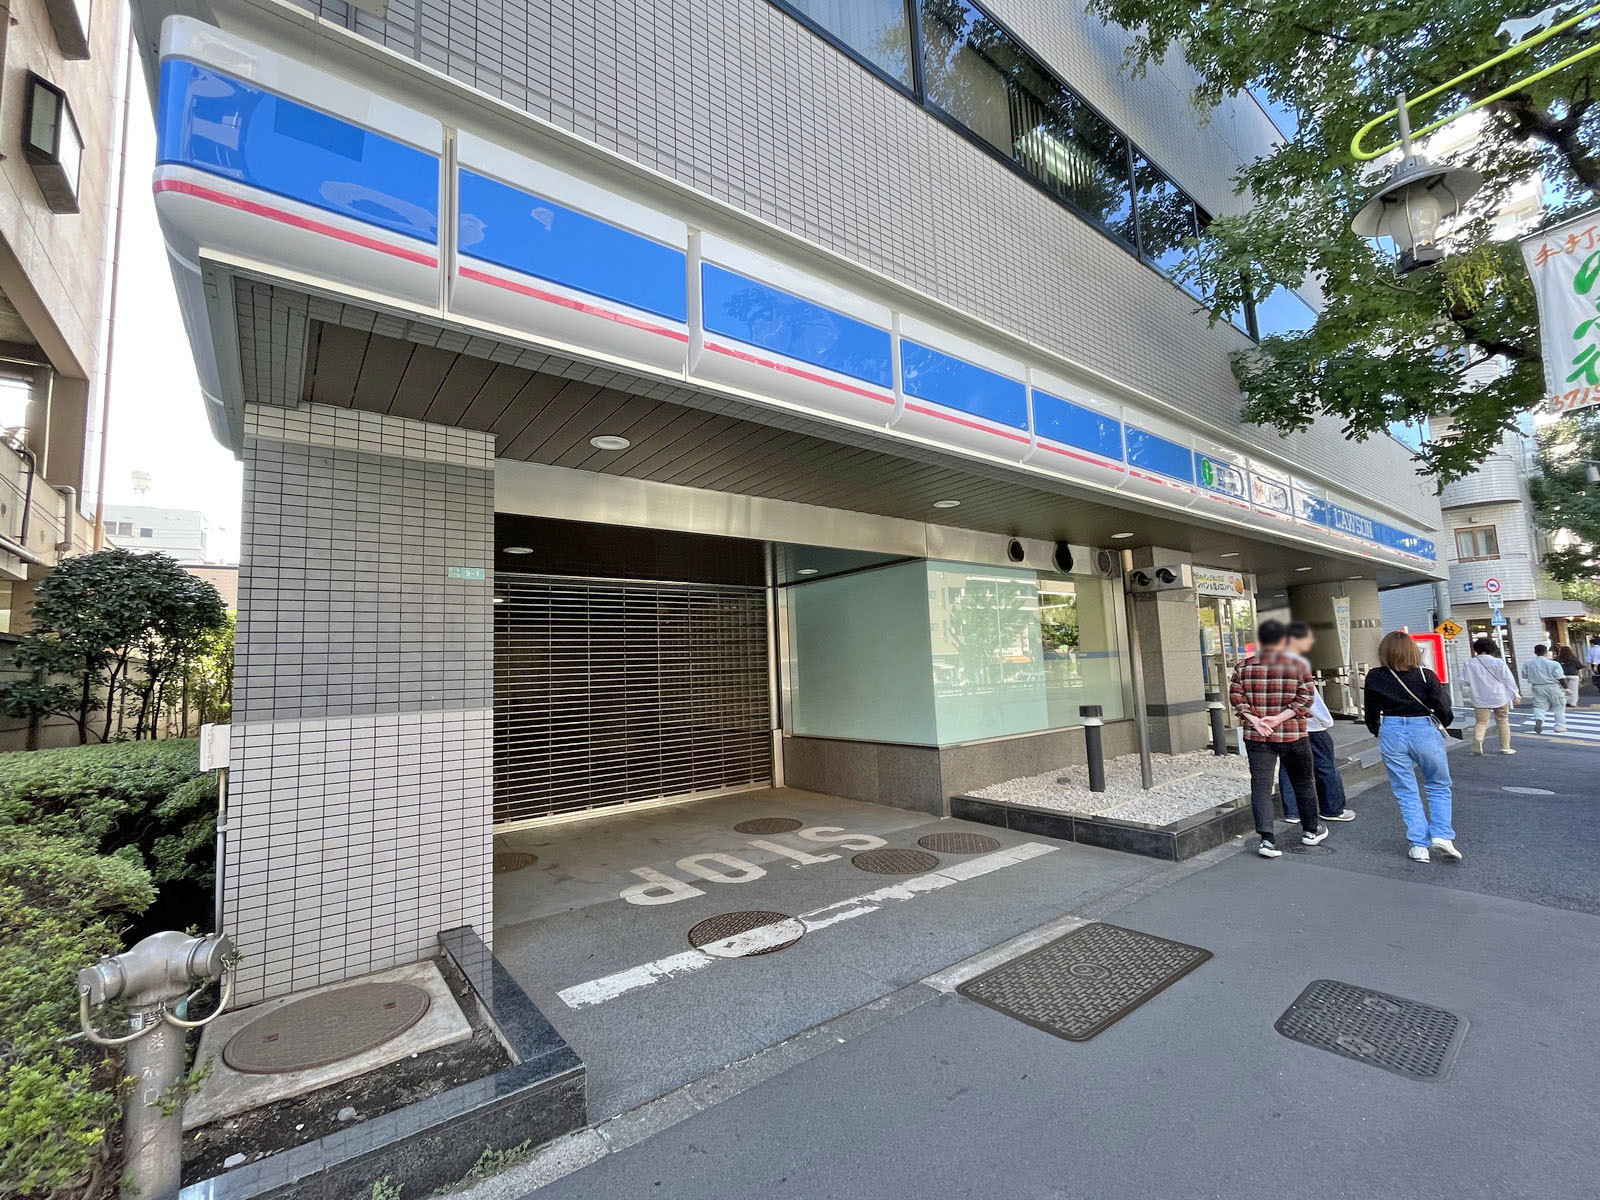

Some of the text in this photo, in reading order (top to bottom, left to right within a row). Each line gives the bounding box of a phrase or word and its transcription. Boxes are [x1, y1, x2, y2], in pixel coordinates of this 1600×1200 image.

[1535, 225, 1600, 267] 手打
[1333, 507, 1373, 538] LAWSON
[619, 826, 888, 905] STOP
